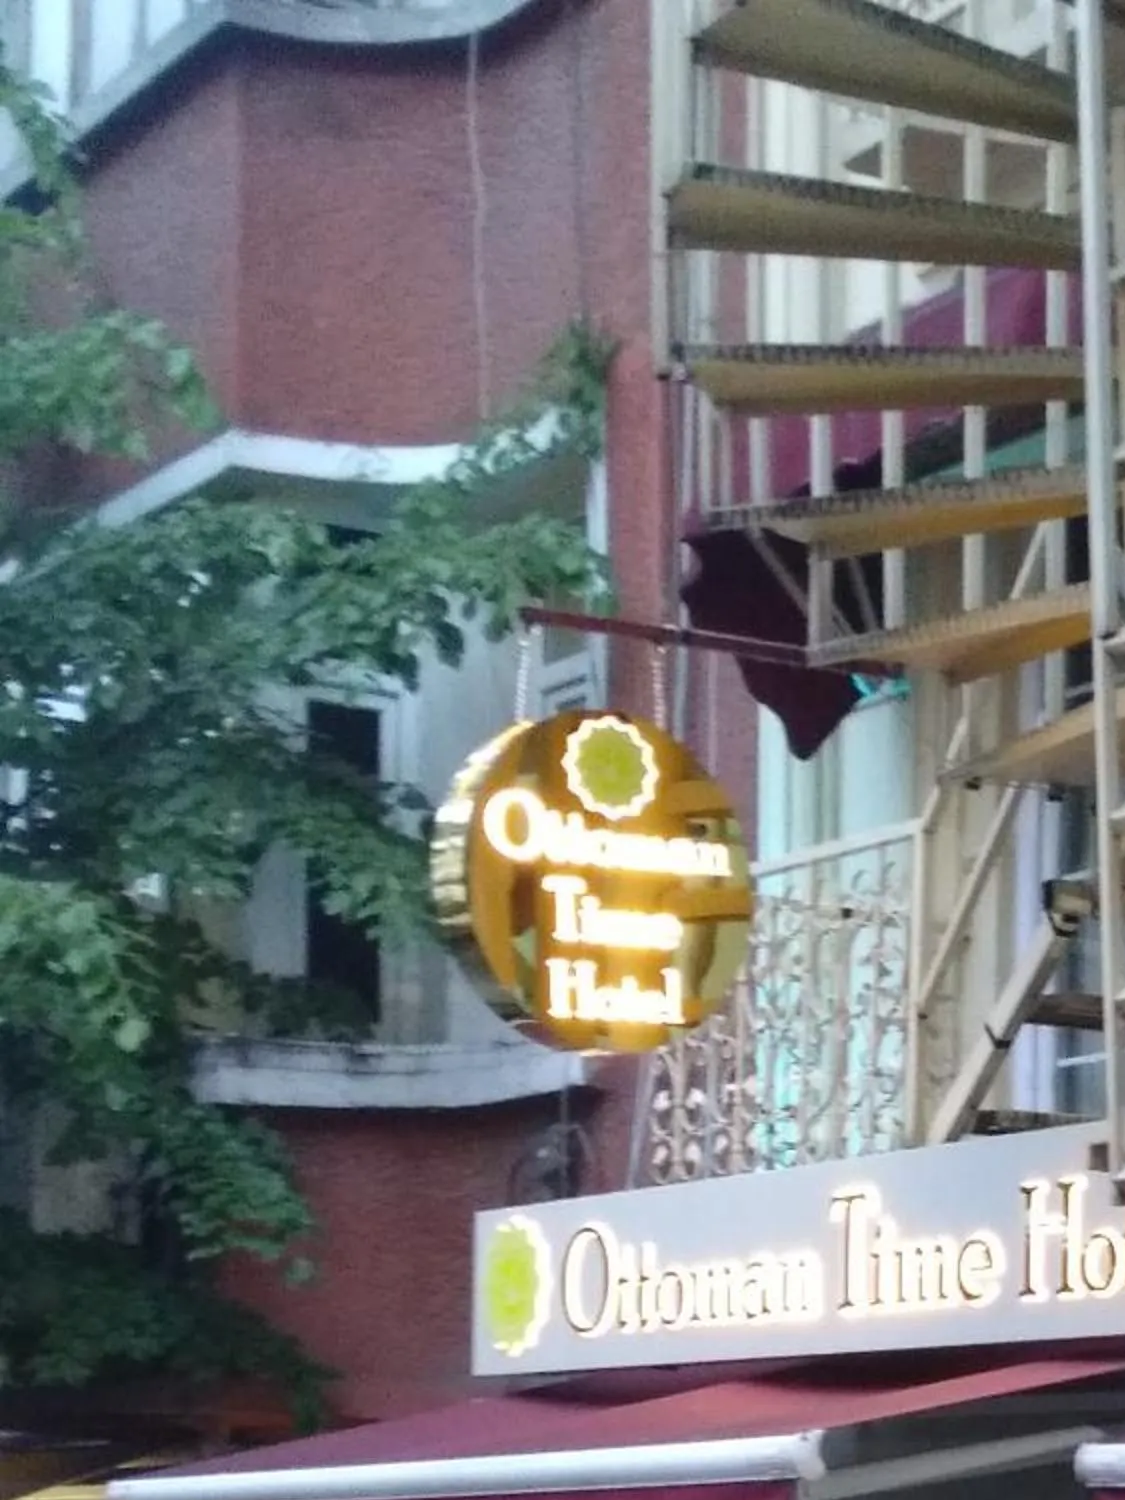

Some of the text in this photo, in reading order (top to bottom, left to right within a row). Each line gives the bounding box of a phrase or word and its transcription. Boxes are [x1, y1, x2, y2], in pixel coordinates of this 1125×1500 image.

[484, 787, 732, 877] Ottoman
[542, 875, 684, 951] Time
[545, 957, 685, 1025] Hotel
[560, 1222, 820, 1338] Ottoman
[831, 1183, 1000, 1312] Time
